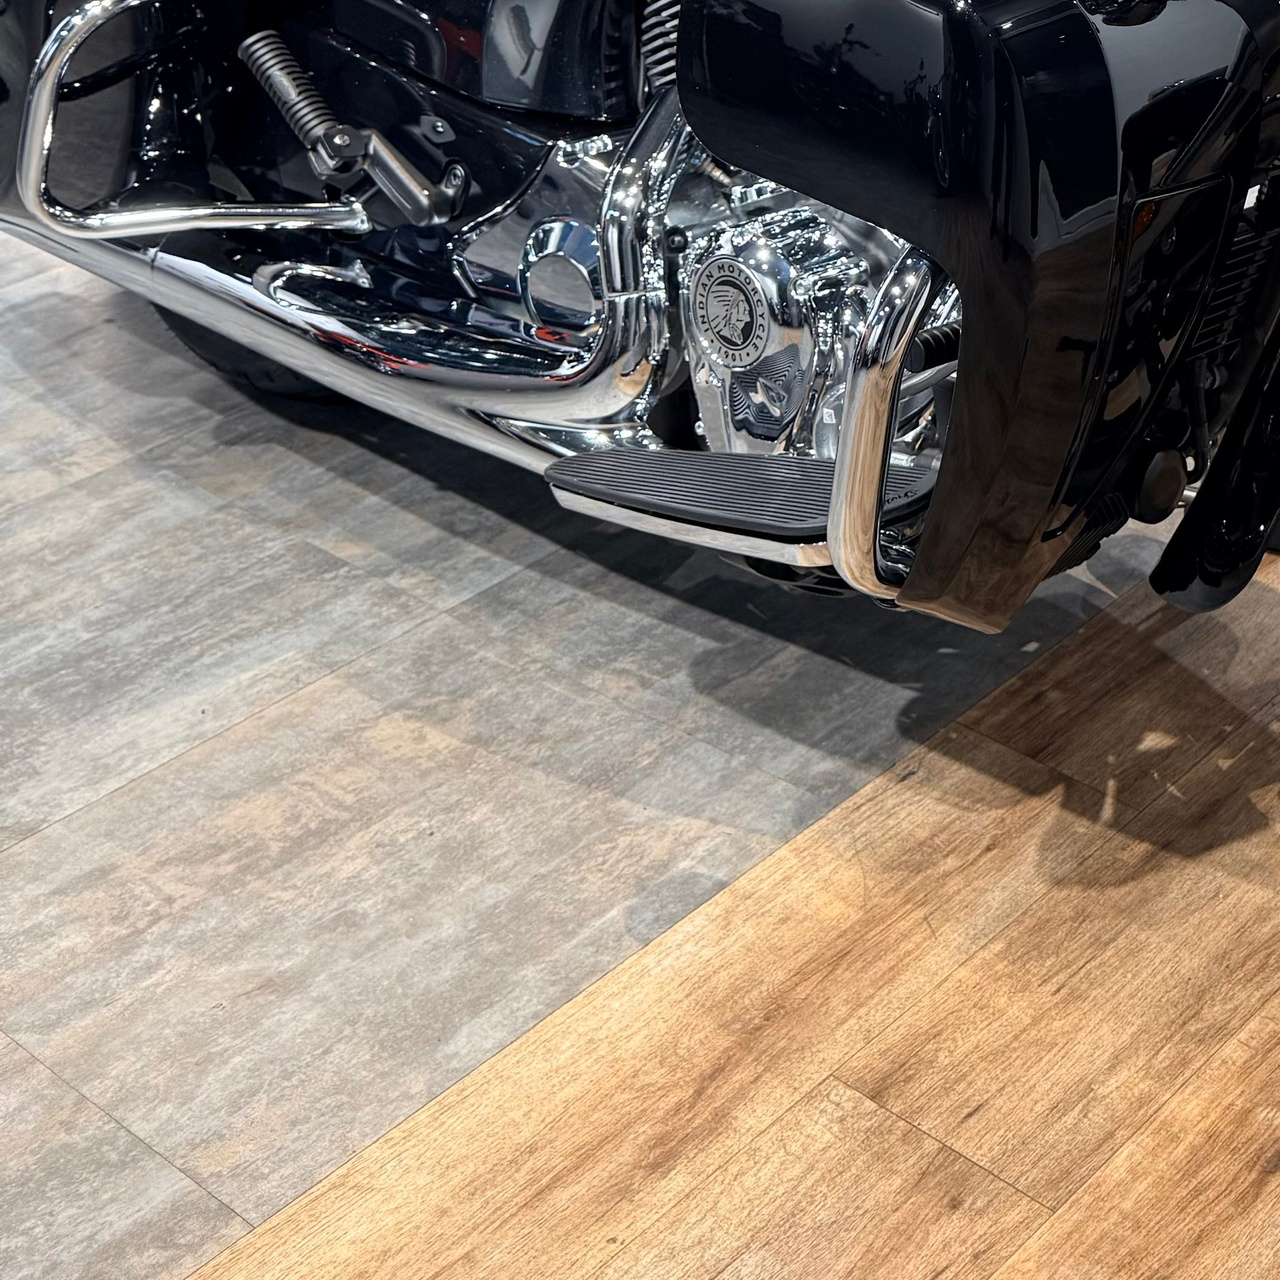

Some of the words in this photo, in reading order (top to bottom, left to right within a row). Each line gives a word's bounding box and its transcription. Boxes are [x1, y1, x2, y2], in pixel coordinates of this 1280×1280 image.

[697, 271, 715, 333] INDIAN
[717, 264, 765, 352] MOTORCYCLE
[717, 346, 744, 362] 1901
